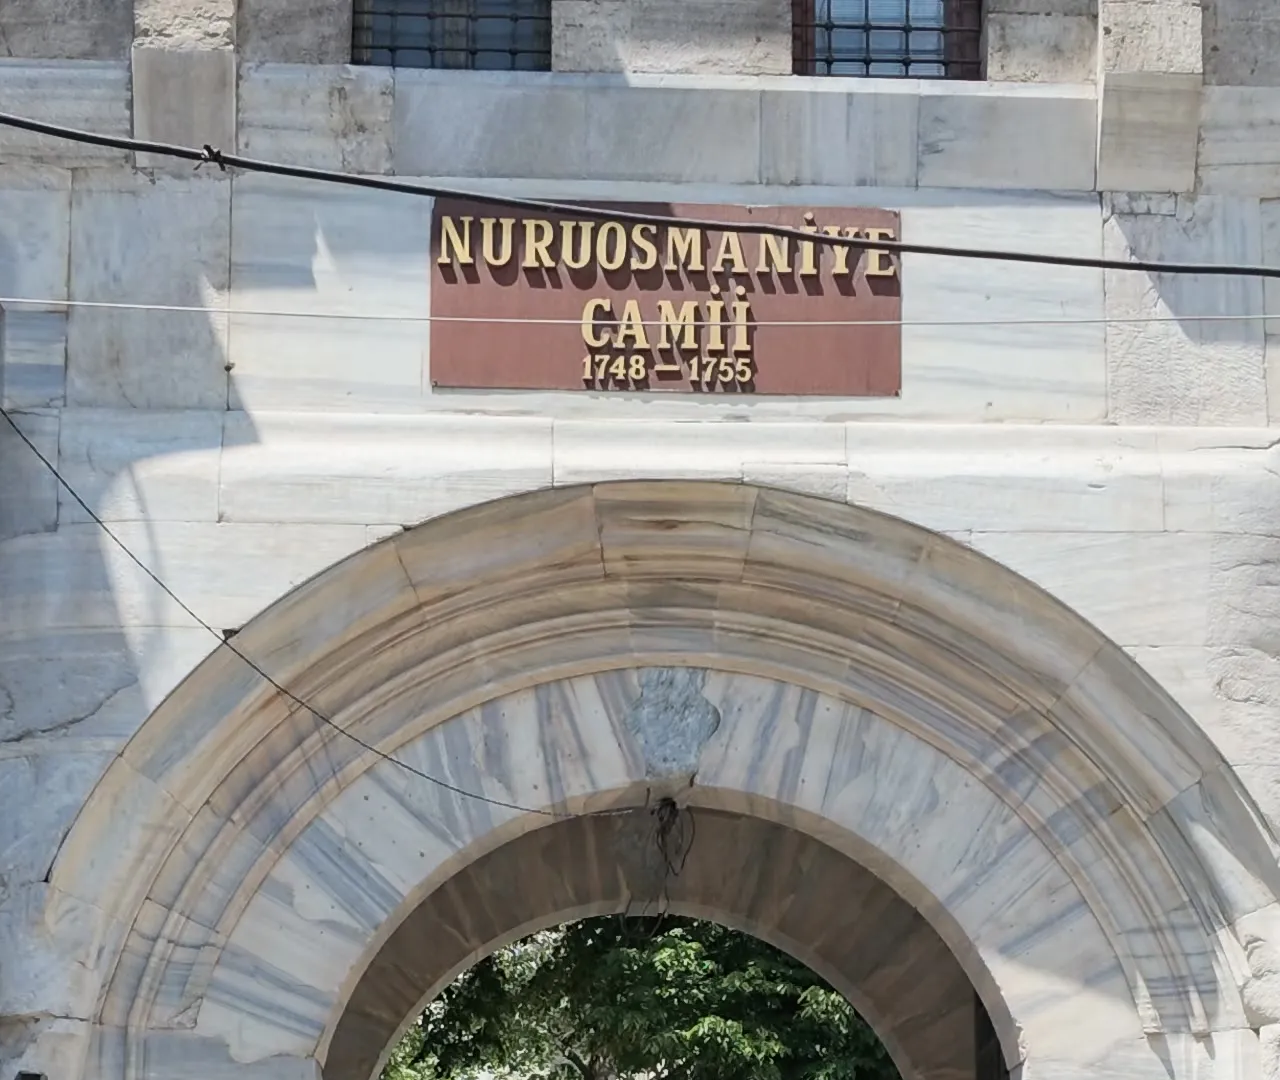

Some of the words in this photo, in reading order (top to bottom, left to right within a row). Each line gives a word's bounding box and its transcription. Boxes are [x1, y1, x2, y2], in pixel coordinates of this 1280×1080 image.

[437, 212, 897, 276] NURUOSMANİYE
[581, 284, 751, 351] CAMİİ
[581, 355, 646, 381] 1748
[688, 357, 752, 382] 1755
